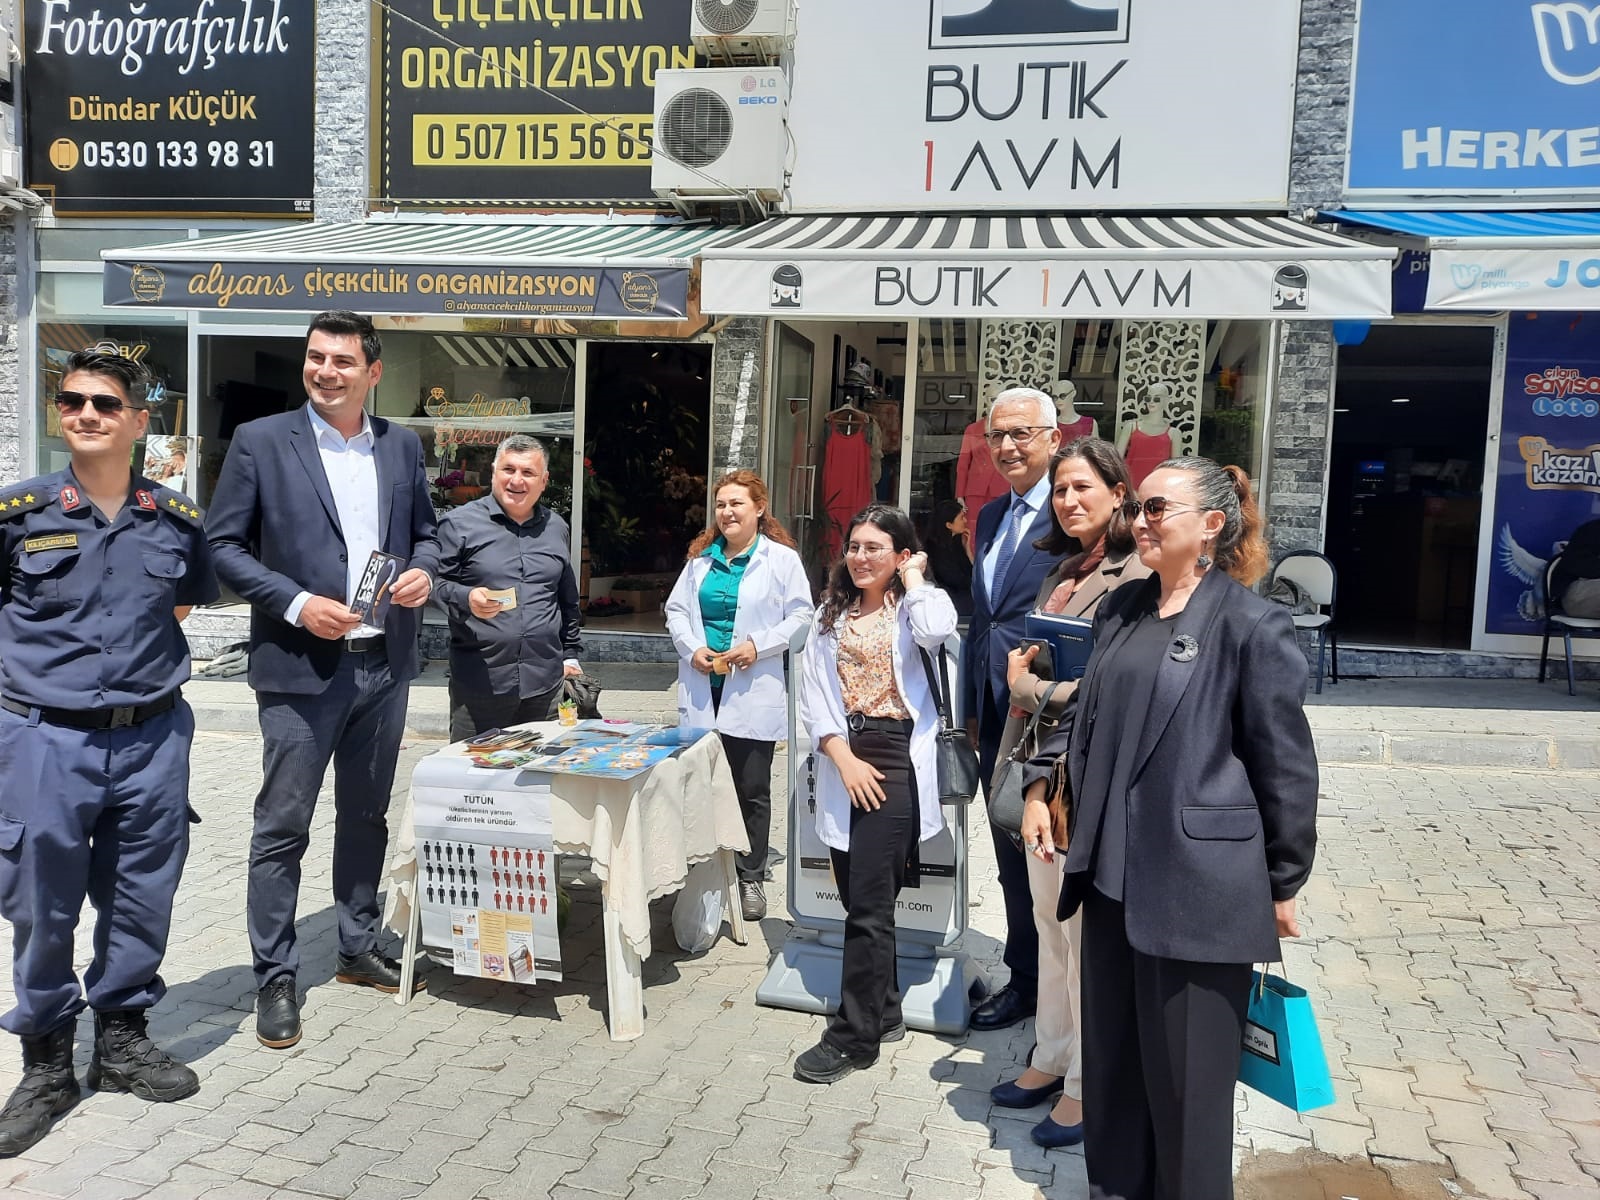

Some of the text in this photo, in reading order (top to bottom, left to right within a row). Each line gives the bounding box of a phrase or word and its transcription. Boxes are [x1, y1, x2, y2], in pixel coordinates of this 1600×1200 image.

[36, 0, 290, 75] Fotoğrafçılık
[401, 40, 696, 88] ORGANİZASYON
[760, 78, 776, 88] LG
[69, 90, 257, 126] Dündar KÜÇÜK
[738, 96, 777, 105] BEKO
[926, 59, 1129, 122] BUTIK
[83, 140, 275, 168] 0530 133 98 31
[427, 123, 652, 160] 0 507 115 56 65
[1402, 126, 1600, 170] HERKE
[188, 262, 295, 308] alyans
[416, 270, 595, 297] ORGANİZASYON
[874, 267, 1012, 307] BUTIK
